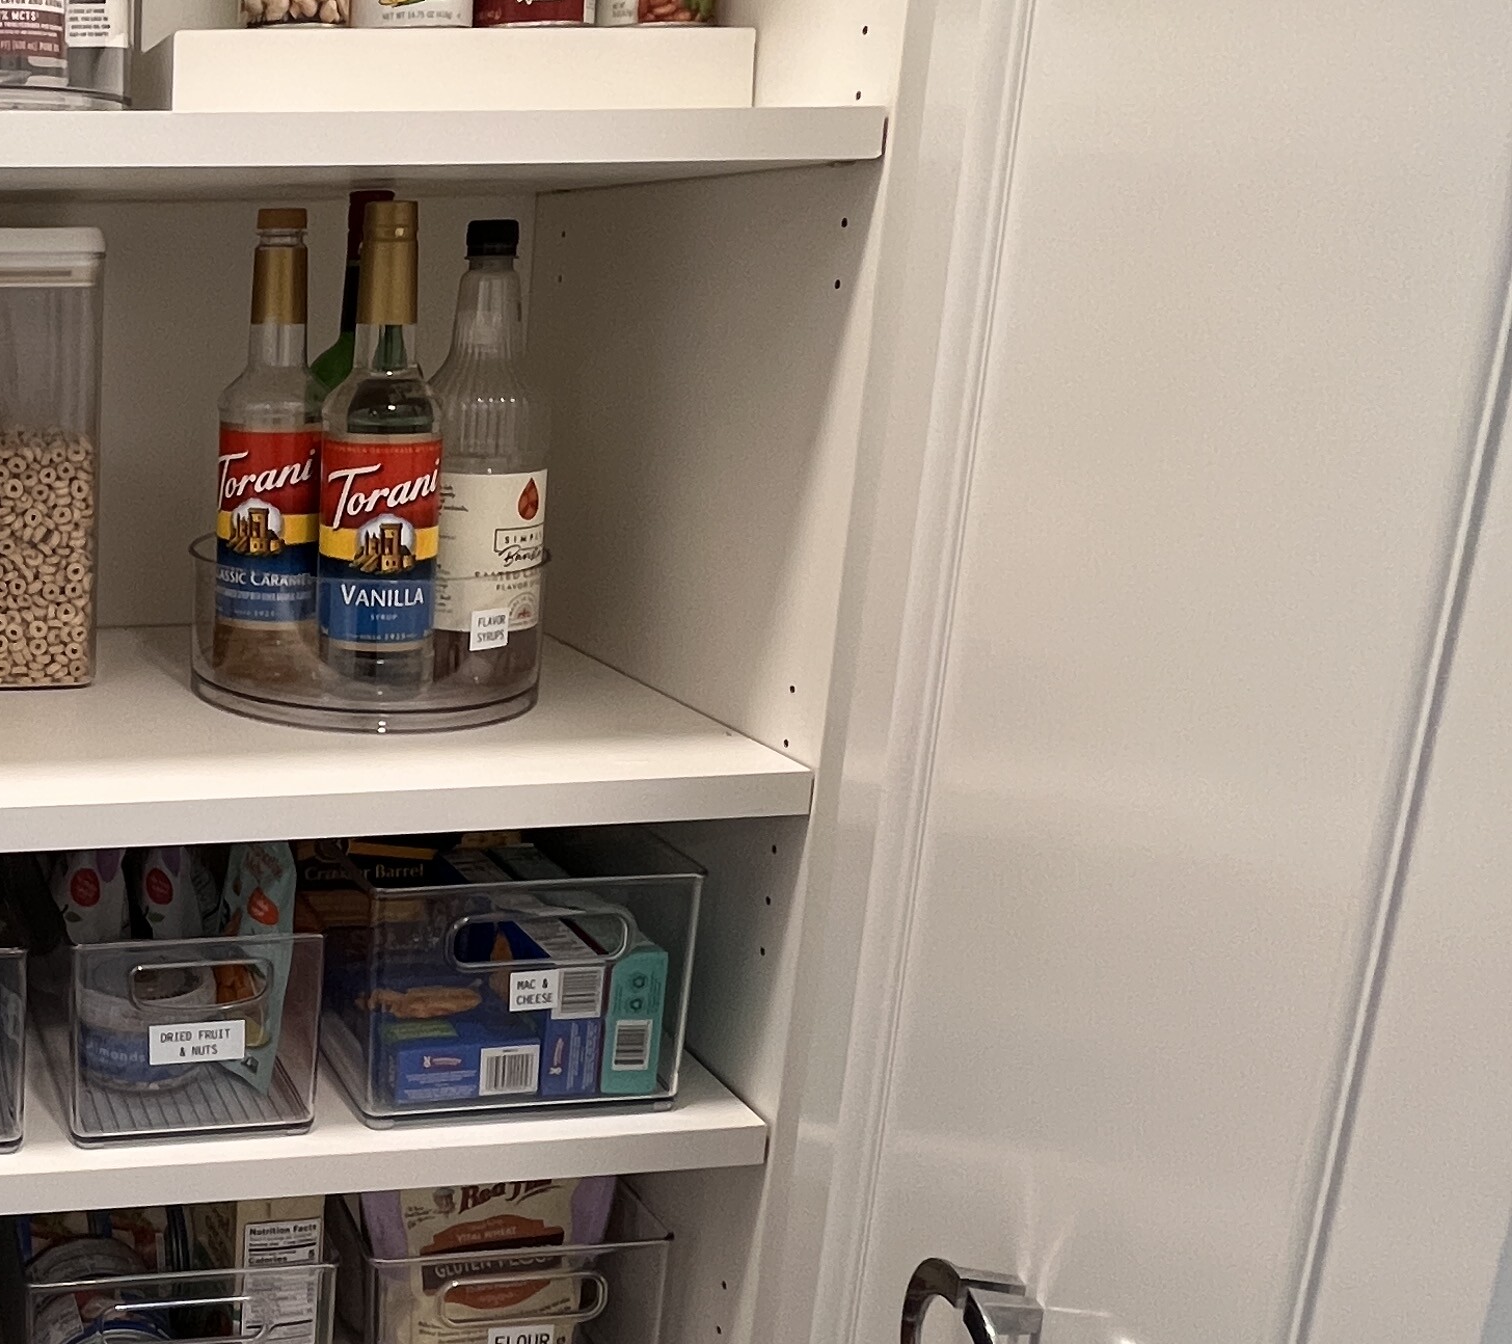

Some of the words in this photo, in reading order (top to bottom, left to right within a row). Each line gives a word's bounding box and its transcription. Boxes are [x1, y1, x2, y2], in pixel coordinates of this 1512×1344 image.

[217, 449, 317, 509] Torani
[329, 458, 440, 528] Torani
[341, 584, 424, 607] VANILLA
[477, 614, 506, 628] FLAVOR
[477, 629, 505, 643] SYRUPS
[375, 862, 425, 879] Barrel
[516, 979, 537, 991] MAC
[542, 978, 549, 989] &
[516, 992, 553, 1005] CHEESE
[160, 1031, 192, 1043] DRIED
[198, 1028, 231, 1040] FRUIT
[179, 1047, 186, 1056] &
[191, 1044, 218, 1056] NUTS
[249, 1227, 290, 1236] Nutrition
[293, 1224, 317, 1233] Facts
